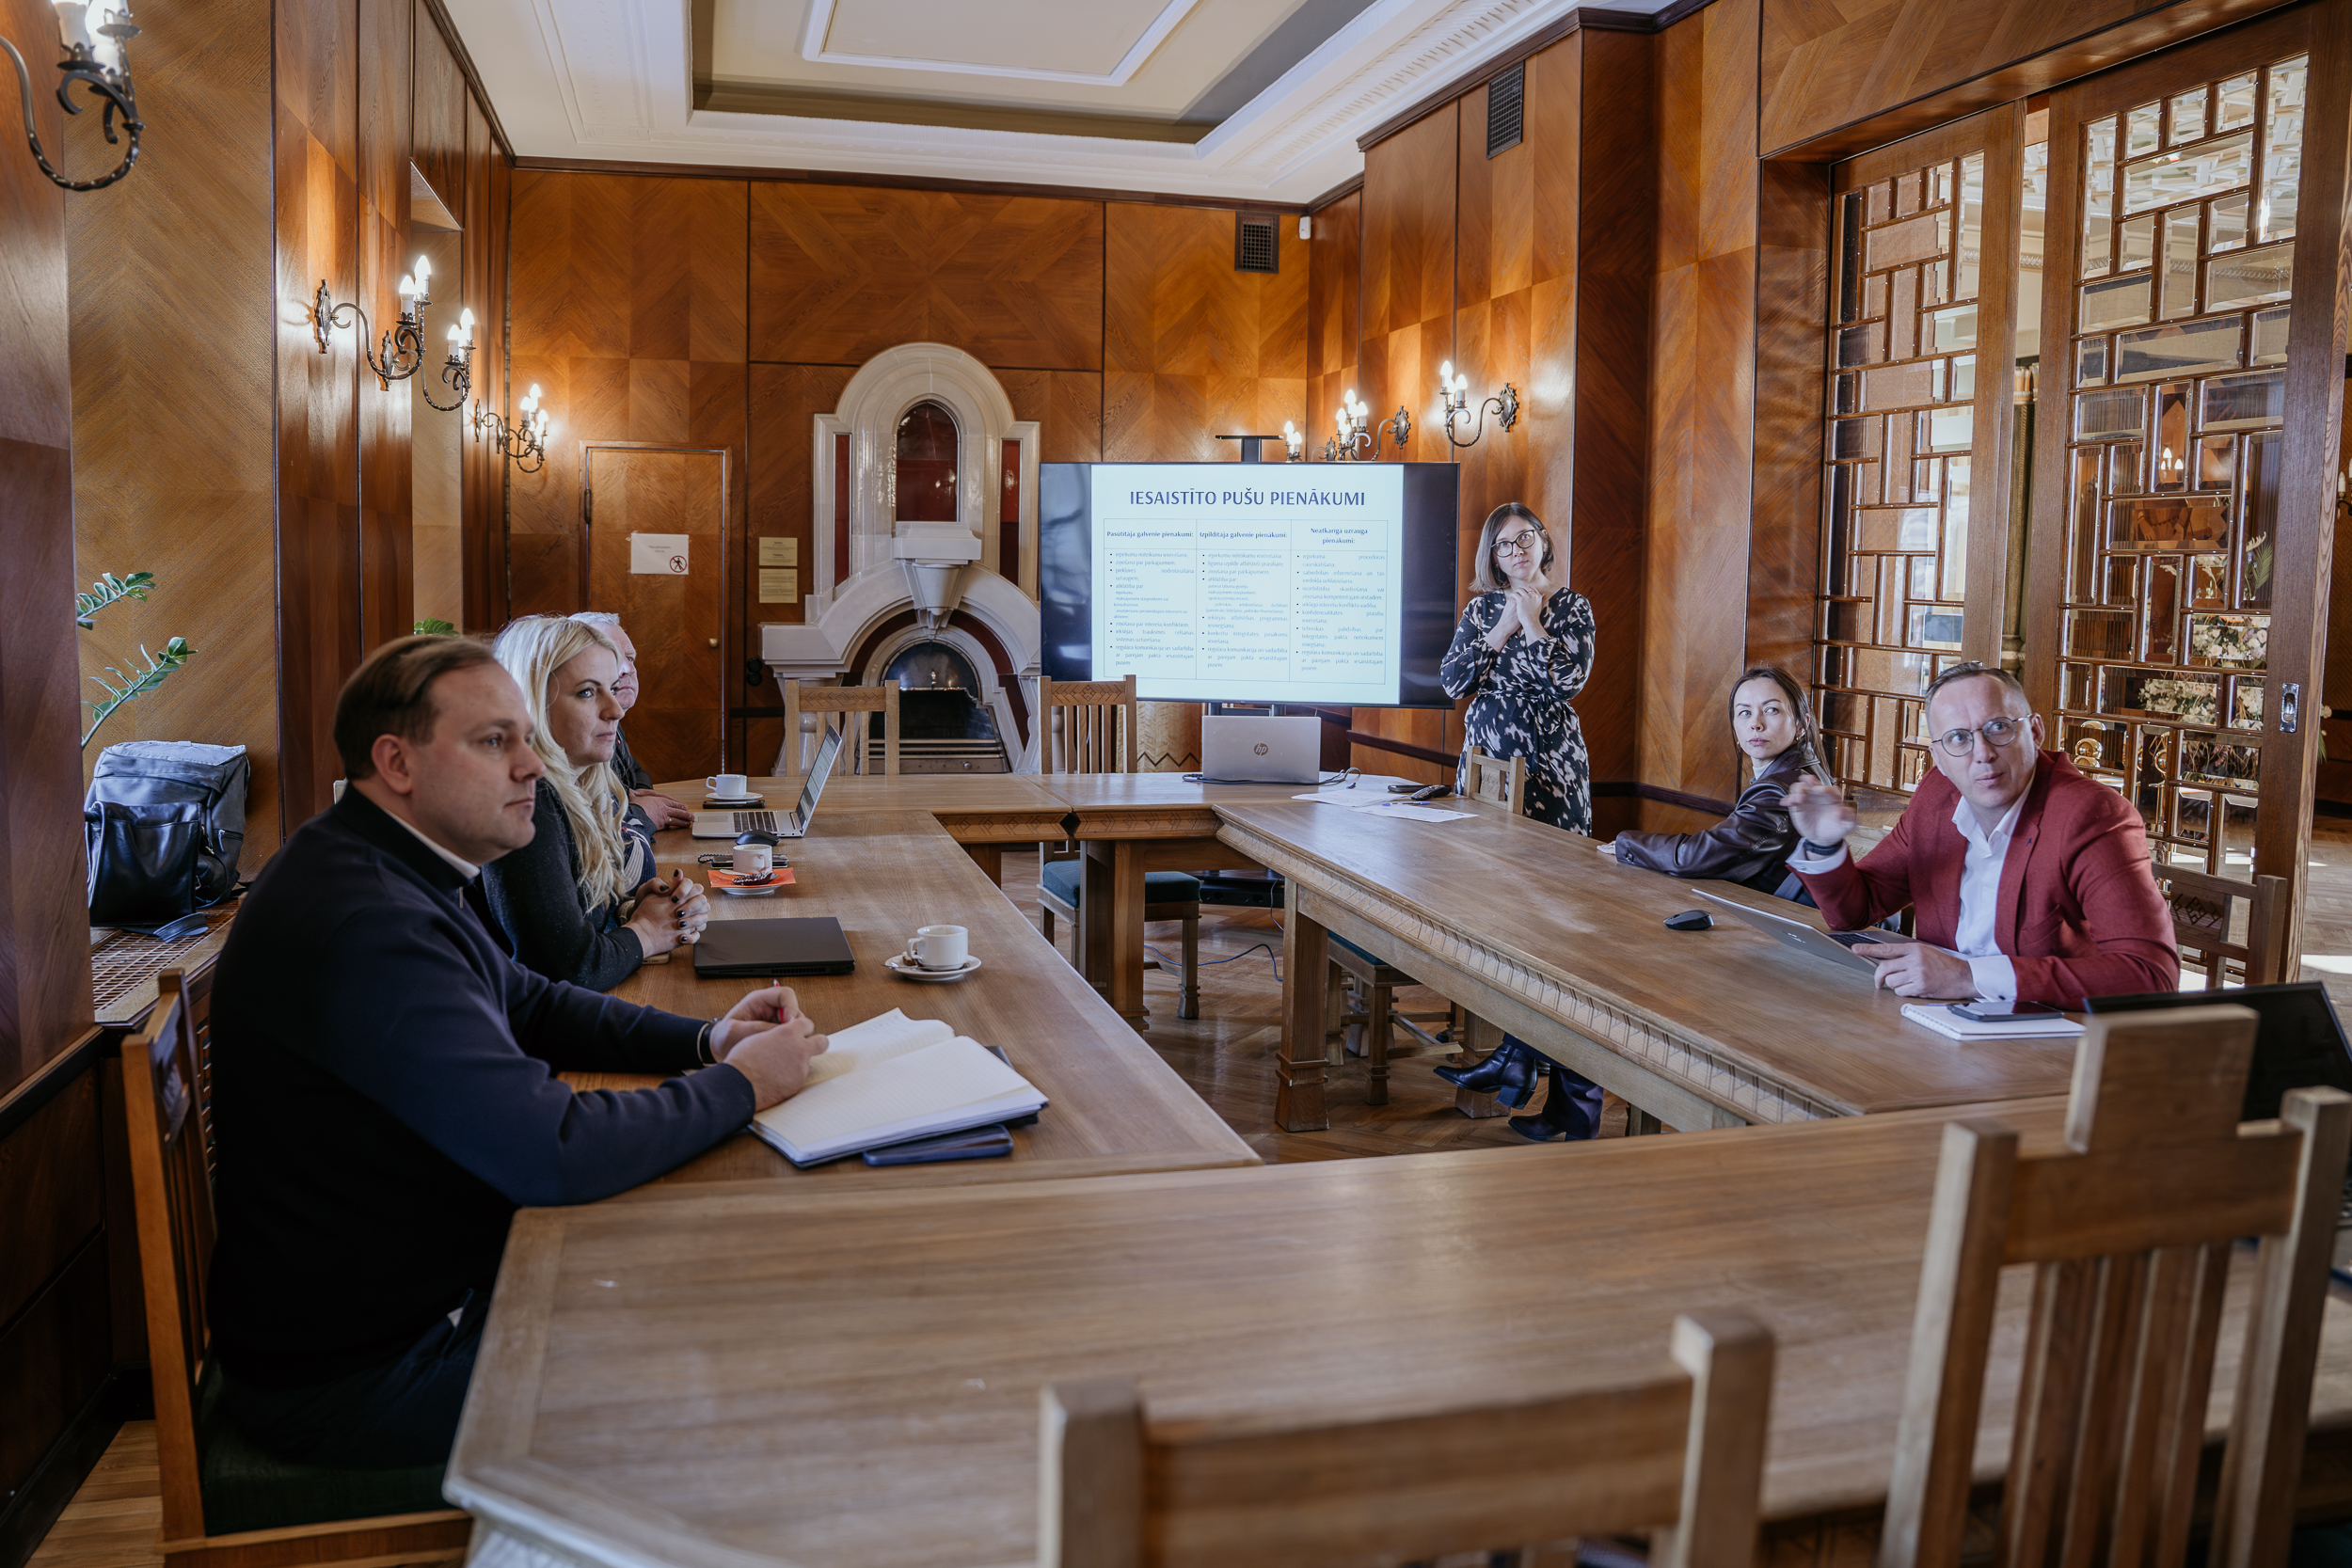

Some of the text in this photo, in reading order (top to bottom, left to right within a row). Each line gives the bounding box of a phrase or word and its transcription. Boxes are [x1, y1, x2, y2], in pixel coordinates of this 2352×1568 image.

[1130, 487, 1365, 506] IESAISTĪTO PUŠU PIENĀKUMI
[1255, 743, 1268, 756] hp
